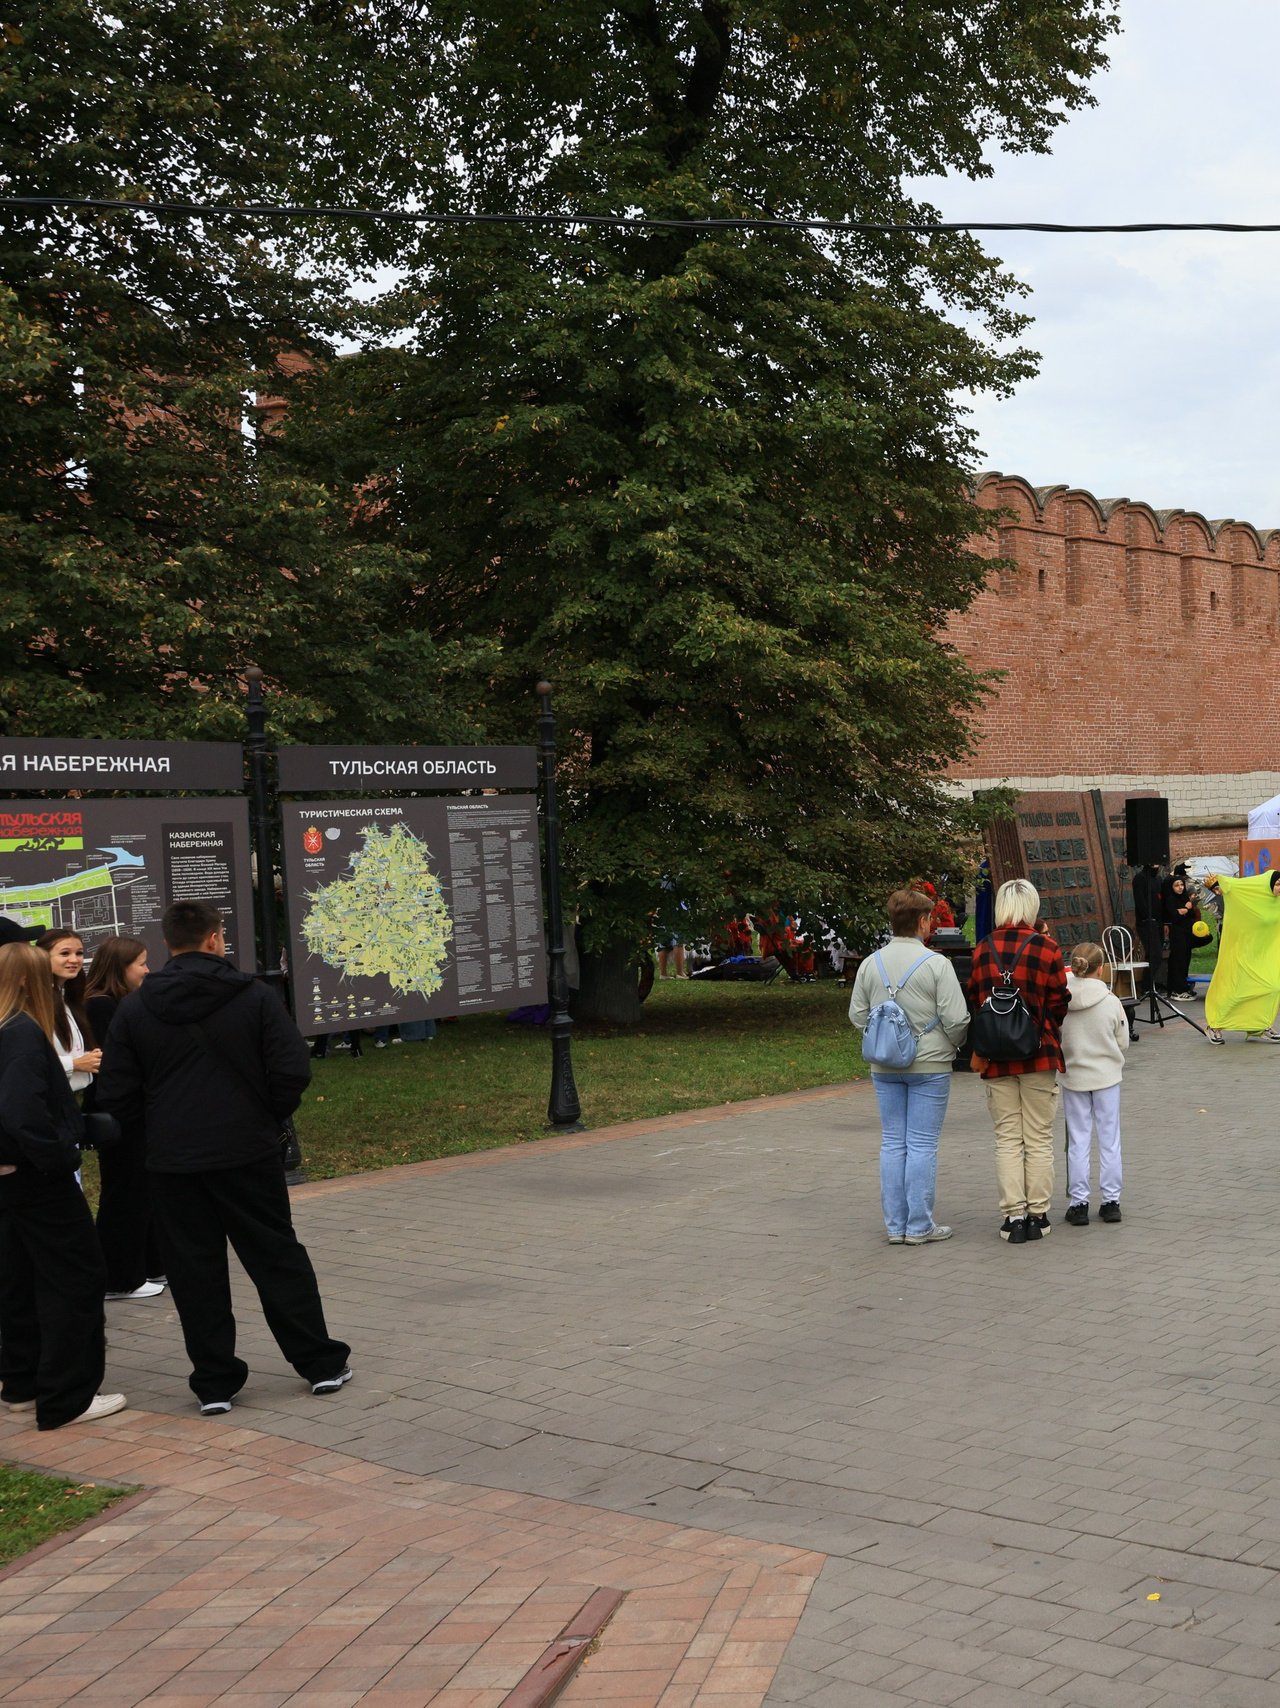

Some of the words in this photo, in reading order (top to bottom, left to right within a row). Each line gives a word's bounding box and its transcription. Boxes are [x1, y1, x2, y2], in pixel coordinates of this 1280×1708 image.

[0, 755, 16, 771] Я
[23, 755, 171, 773] НАБЕРЕЖНАЯ
[329, 760, 418, 775] ТУЛЬСКАЯ
[423, 760, 497, 774] ОБЛАСТЬ
[299, 808, 373, 818] ТУРИСТИЧЕСКАЯ
[374, 807, 403, 816] СХЕМА
[169, 831, 216, 839] КАЗАНСКАЯ
[170, 840, 224, 848] НАБЕРЕЖНАЯ
